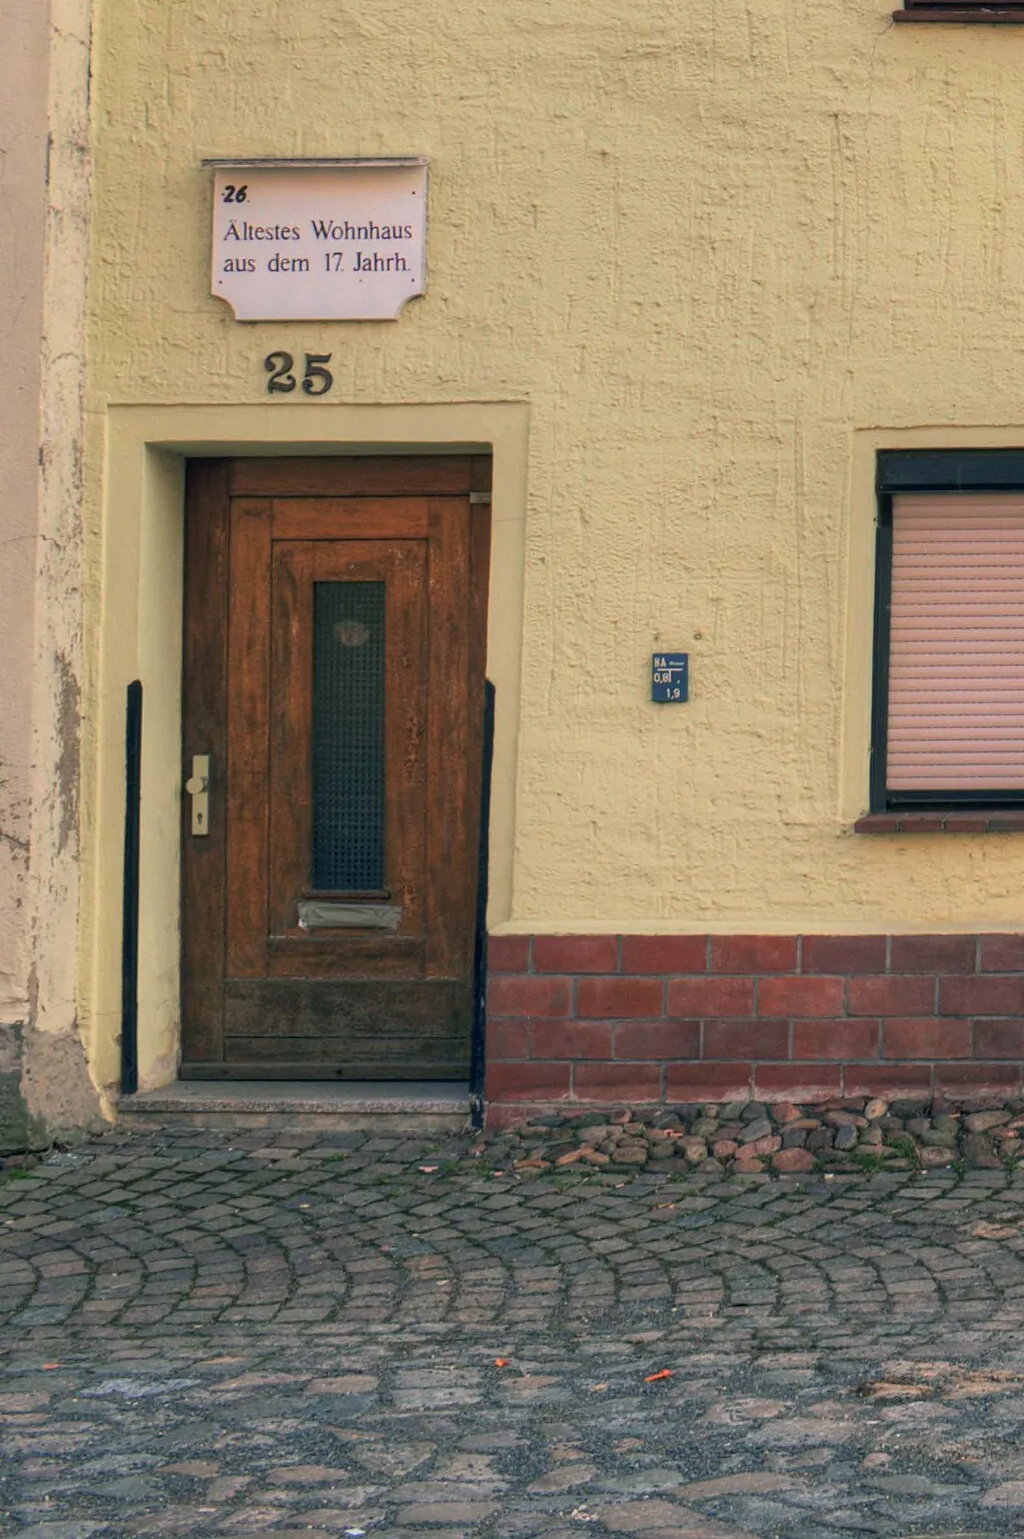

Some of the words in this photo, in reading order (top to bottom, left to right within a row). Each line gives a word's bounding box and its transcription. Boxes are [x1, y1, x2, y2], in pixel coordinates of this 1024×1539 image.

[223, 218, 301, 241] Ältestes
[311, 219, 413, 240] Wohnhaus
[223, 257, 256, 273] aus
[267, 252, 310, 273] dem
[352, 251, 411, 273] Jahrh.
[264, 350, 334, 396] 25
